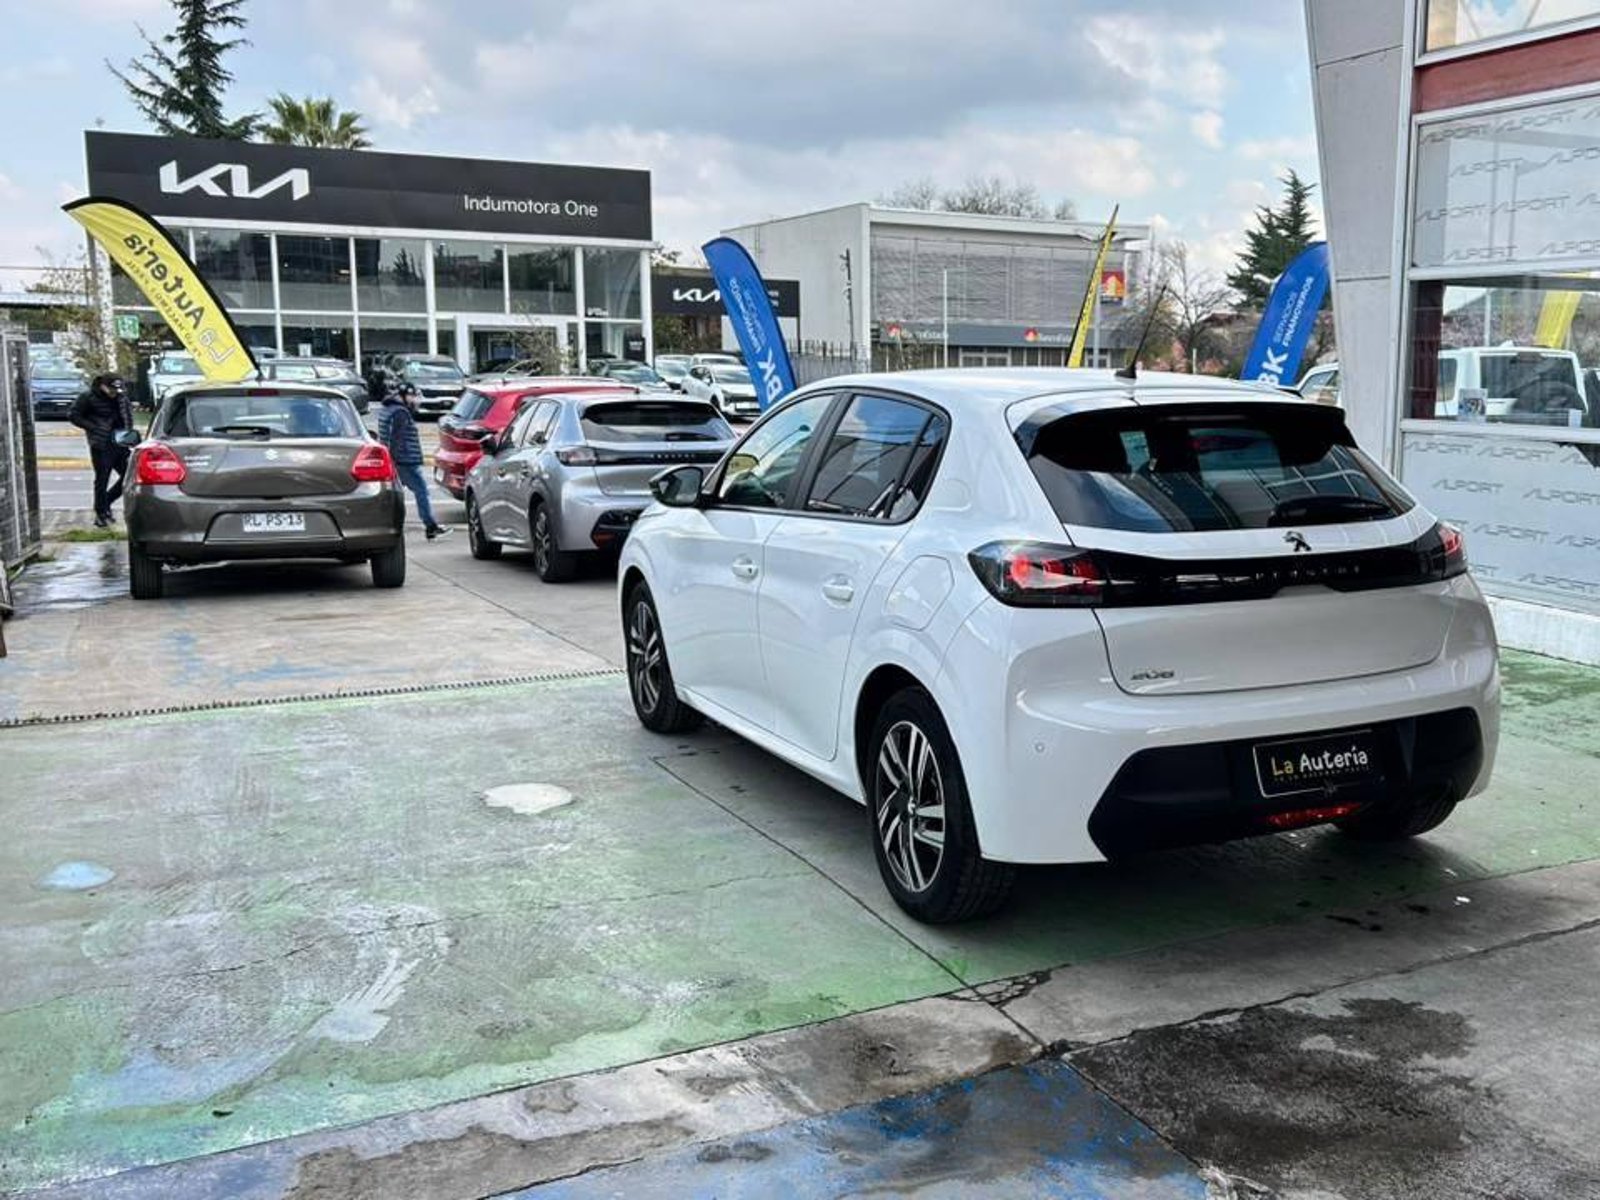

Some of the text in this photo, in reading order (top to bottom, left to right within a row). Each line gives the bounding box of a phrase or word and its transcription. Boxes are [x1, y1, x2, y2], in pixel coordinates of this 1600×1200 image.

[1535, 146, 1600, 168] ALPO
[159, 160, 310, 201] KIA
[464, 194, 599, 218] Indumotora One
[1536, 239, 1600, 256] ALPOR
[1432, 478, 1504, 495] ALPORT
[1270, 757, 1295, 776] La
[1299, 745, 1369, 773] Autería
